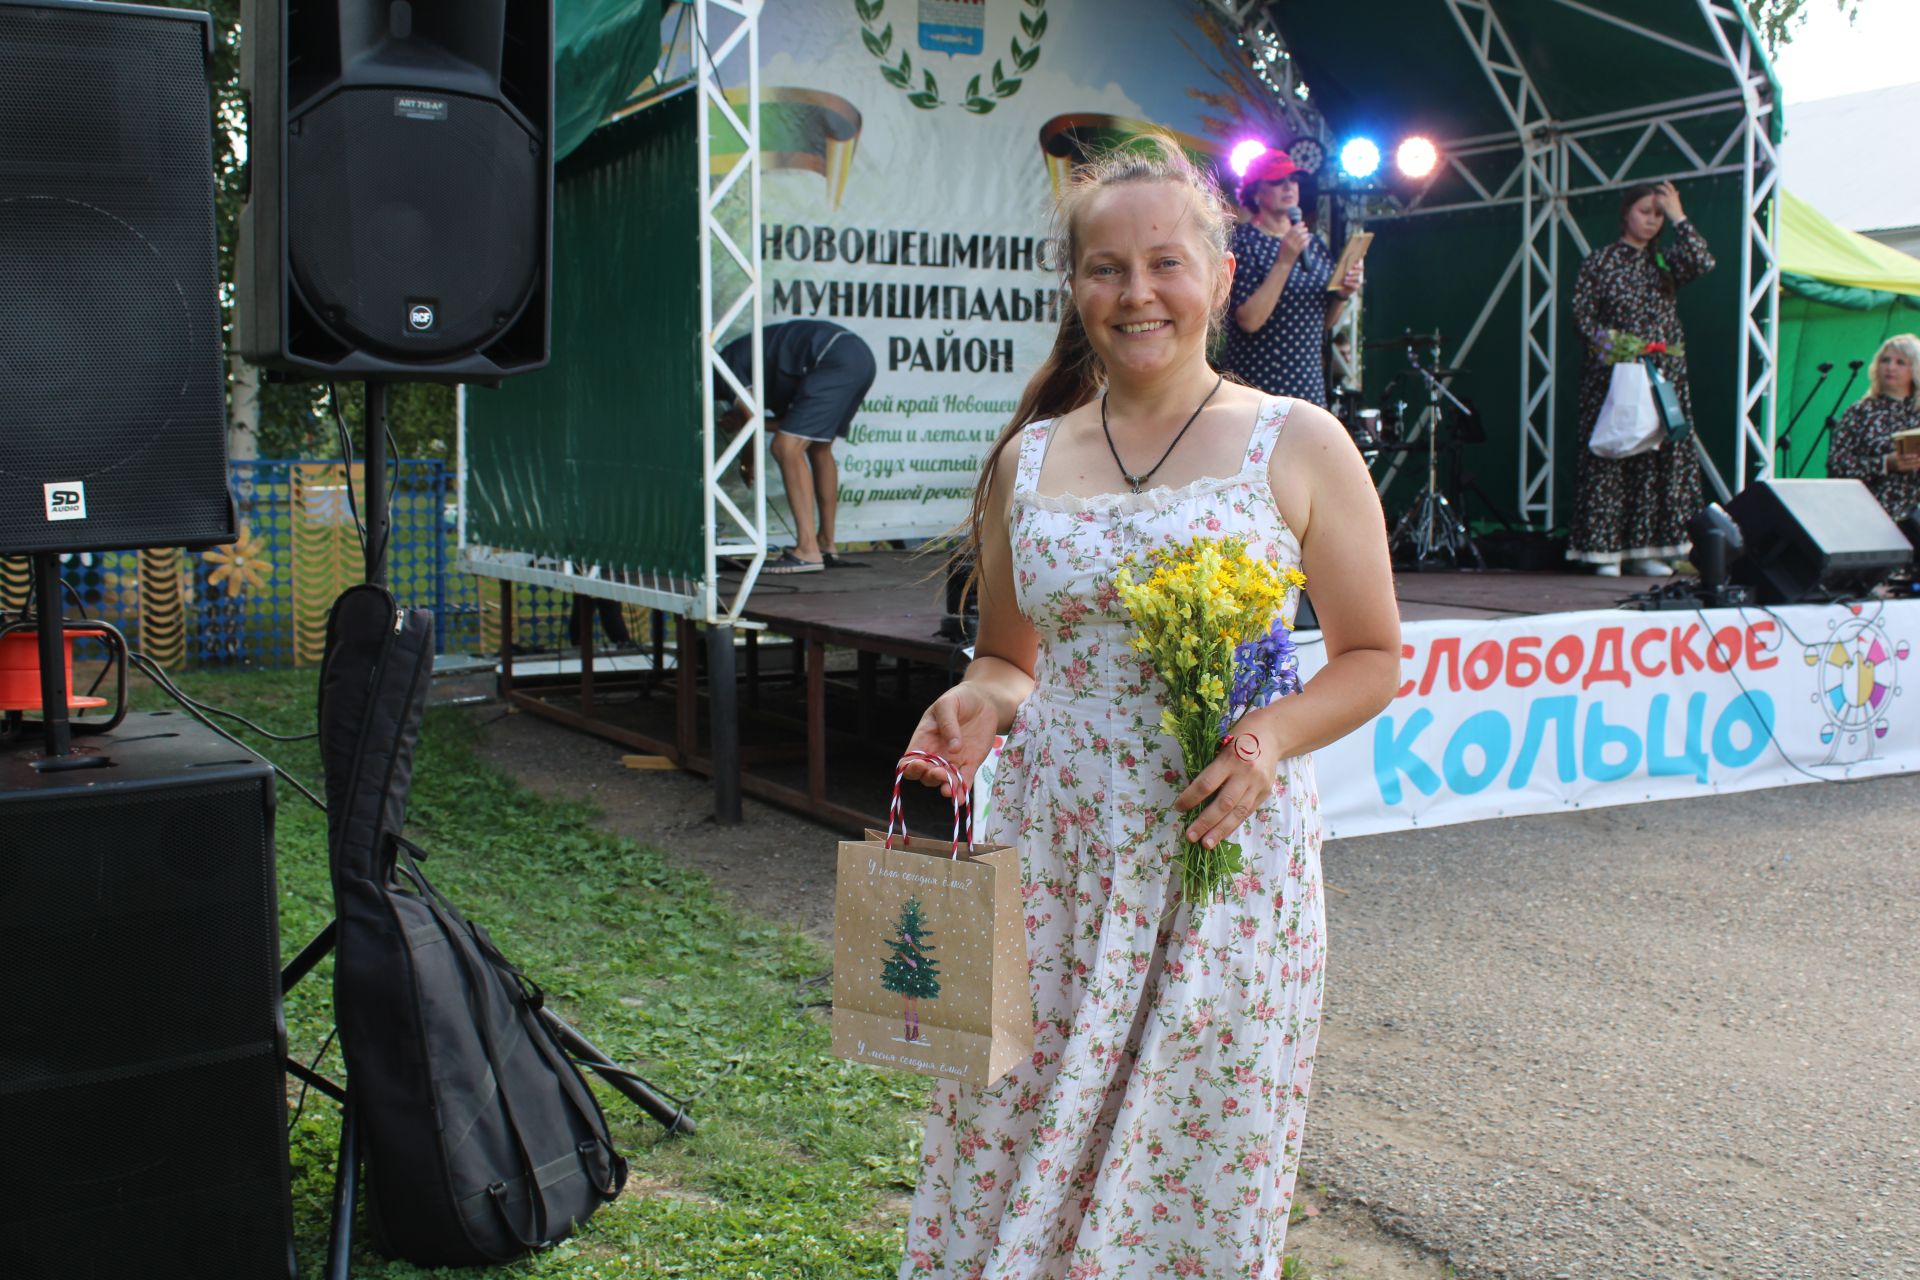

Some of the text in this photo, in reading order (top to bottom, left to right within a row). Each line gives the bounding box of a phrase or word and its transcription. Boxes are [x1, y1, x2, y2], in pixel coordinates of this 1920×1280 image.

[760, 223, 1066, 273] НОВОШЕШМИНС
[412, 312, 430, 323] RCF
[888, 328, 1014, 374] РАЙОН
[896, 394, 939, 419] край
[845, 424, 996, 446] Цвети и летом и
[844, 454, 905, 479] воздух
[909, 453, 977, 472] чистый
[52, 490, 80, 505] SD
[867, 484, 923, 502] тихой
[1373, 688, 1775, 806] КОЛЬЦО
[868, 858, 877, 875] У
[857, 1039, 866, 1056] У
